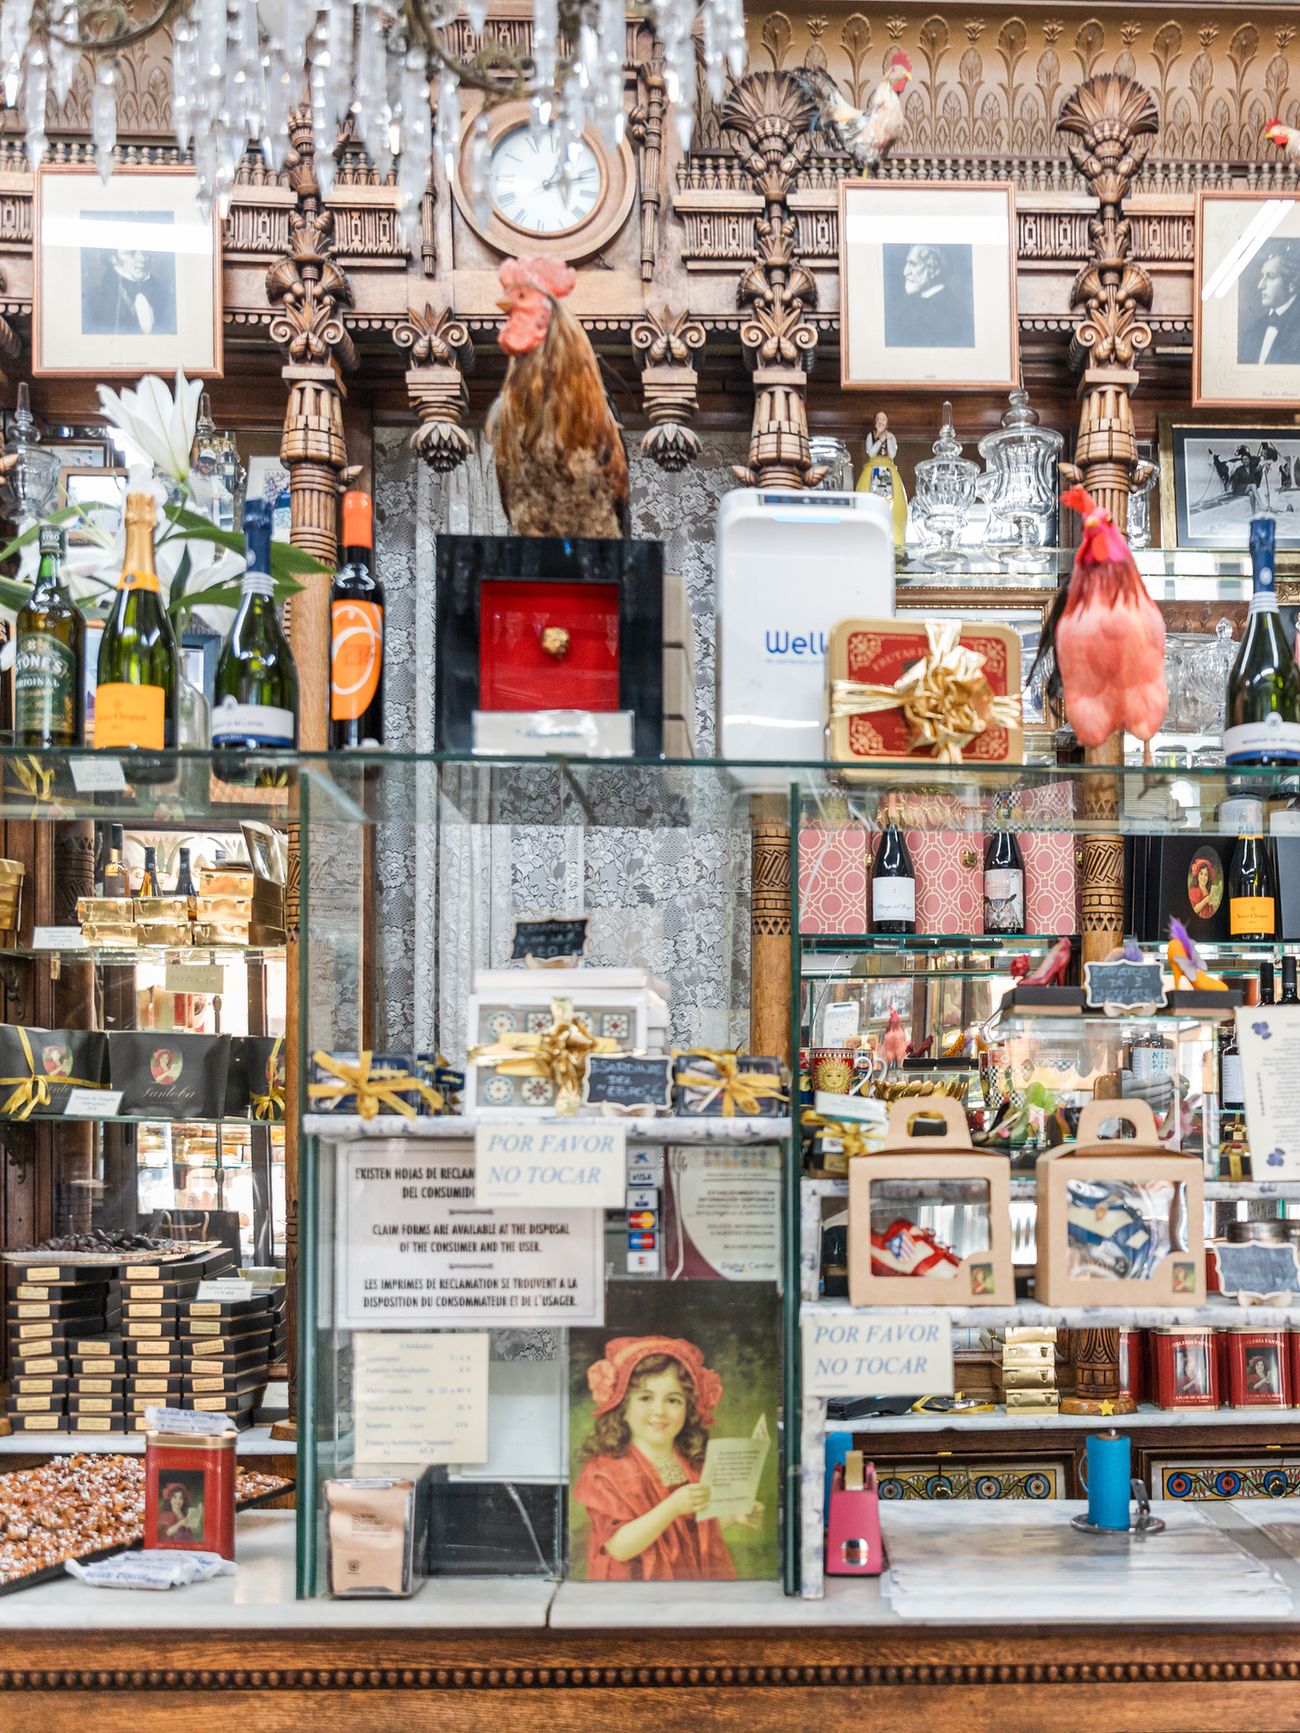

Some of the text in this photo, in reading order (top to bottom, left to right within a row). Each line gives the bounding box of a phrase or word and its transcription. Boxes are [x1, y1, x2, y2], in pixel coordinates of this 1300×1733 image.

[487, 1134, 615, 1152] POR FAVOR
[355, 1167, 391, 1179] EXISTEN
[395, 1167, 423, 1180] HOJAS
[426, 1167, 437, 1179] DE
[487, 1166, 601, 1184] NO TOCAR
[402, 1186, 418, 1198] DEL
[373, 1223, 570, 1235] CLAIM FORMS ARE AVAILABLE AT THE DISPOSAL
[400, 1241, 542, 1252] OF THE CONSUMER AND THE USER.
[365, 1278, 578, 1290] LES IMPRIMES DE RECLAMATION SE TROUVENT A LA
[364, 1296, 418, 1307] DISPOSITION
[421, 1296, 433, 1307] DU
[436, 1296, 507, 1307] CONSOMMATEUR
[510, 1296, 519, 1307] ET
[521, 1295, 531, 1306] DE
[814, 1324, 940, 1343] POR FAVOR
[814, 1356, 928, 1376] NO TOCAR
